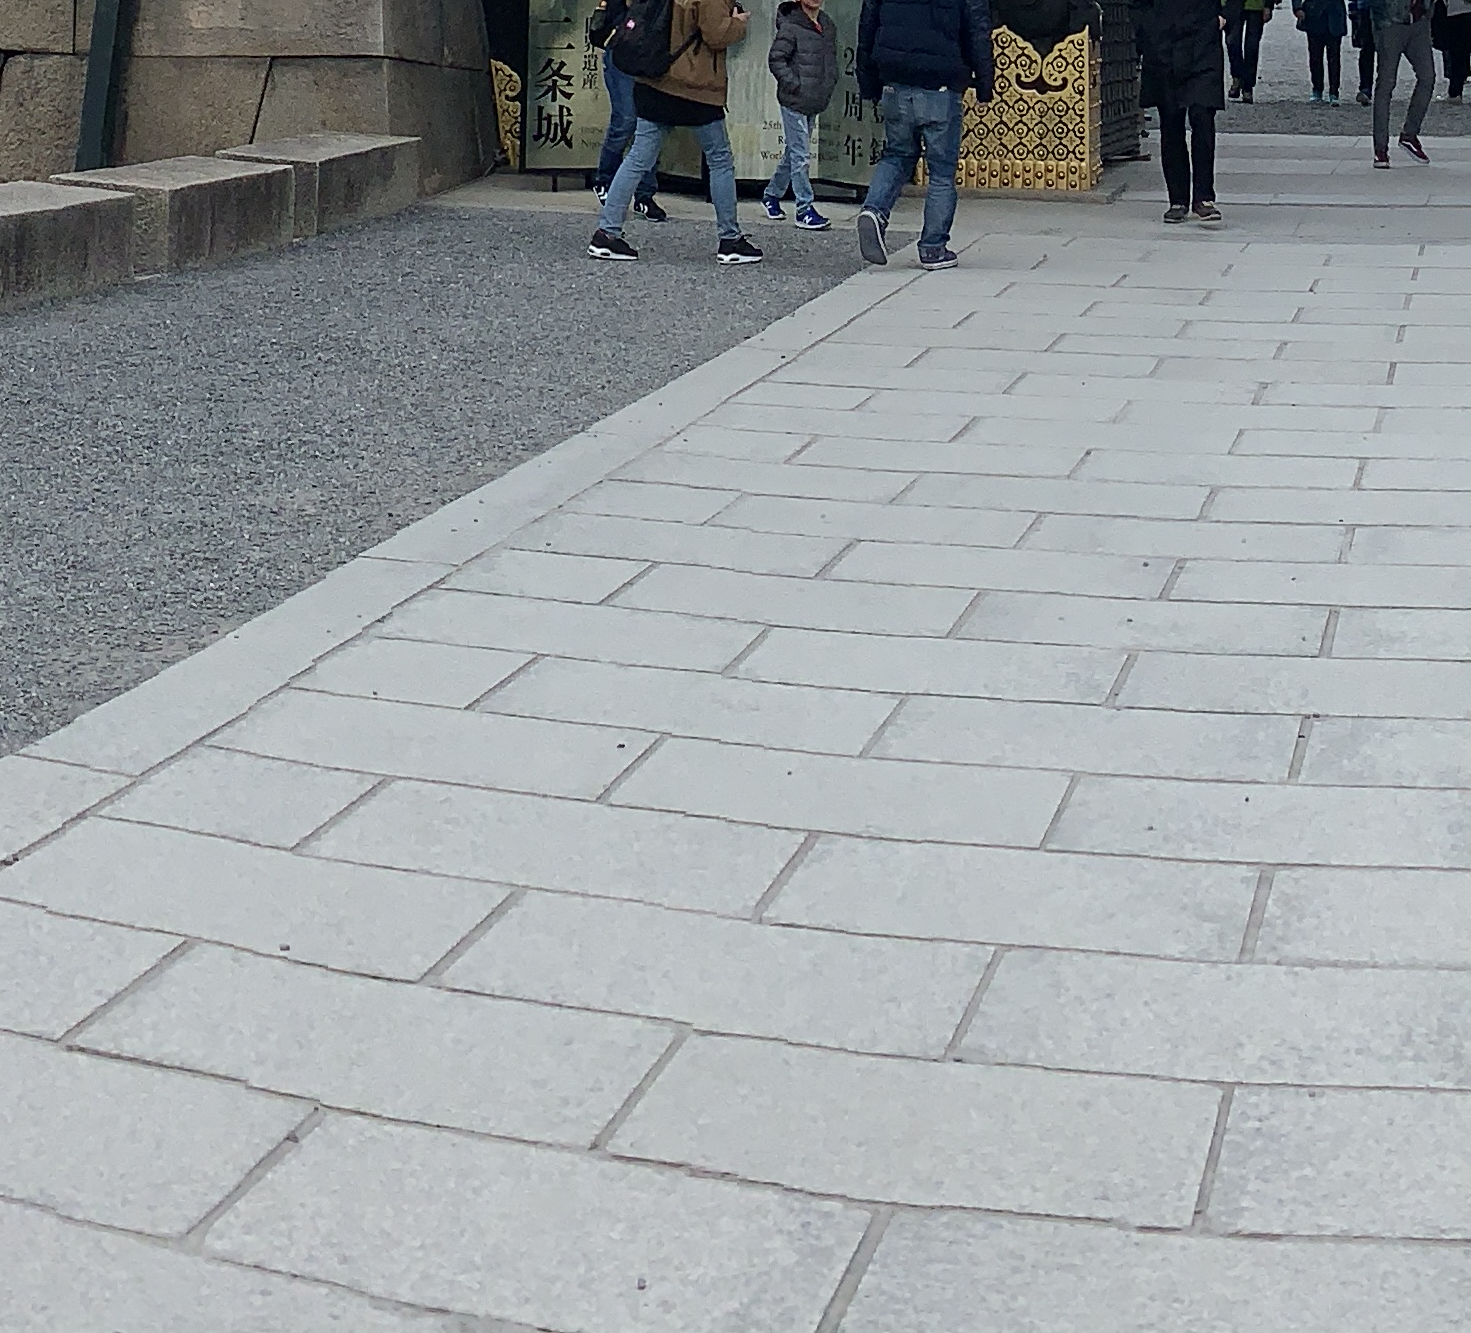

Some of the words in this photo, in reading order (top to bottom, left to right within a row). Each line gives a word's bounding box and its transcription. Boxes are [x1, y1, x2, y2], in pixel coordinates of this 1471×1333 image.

[532, 16, 575, 150] 二条城
[842, 46, 864, 167] 2周年
